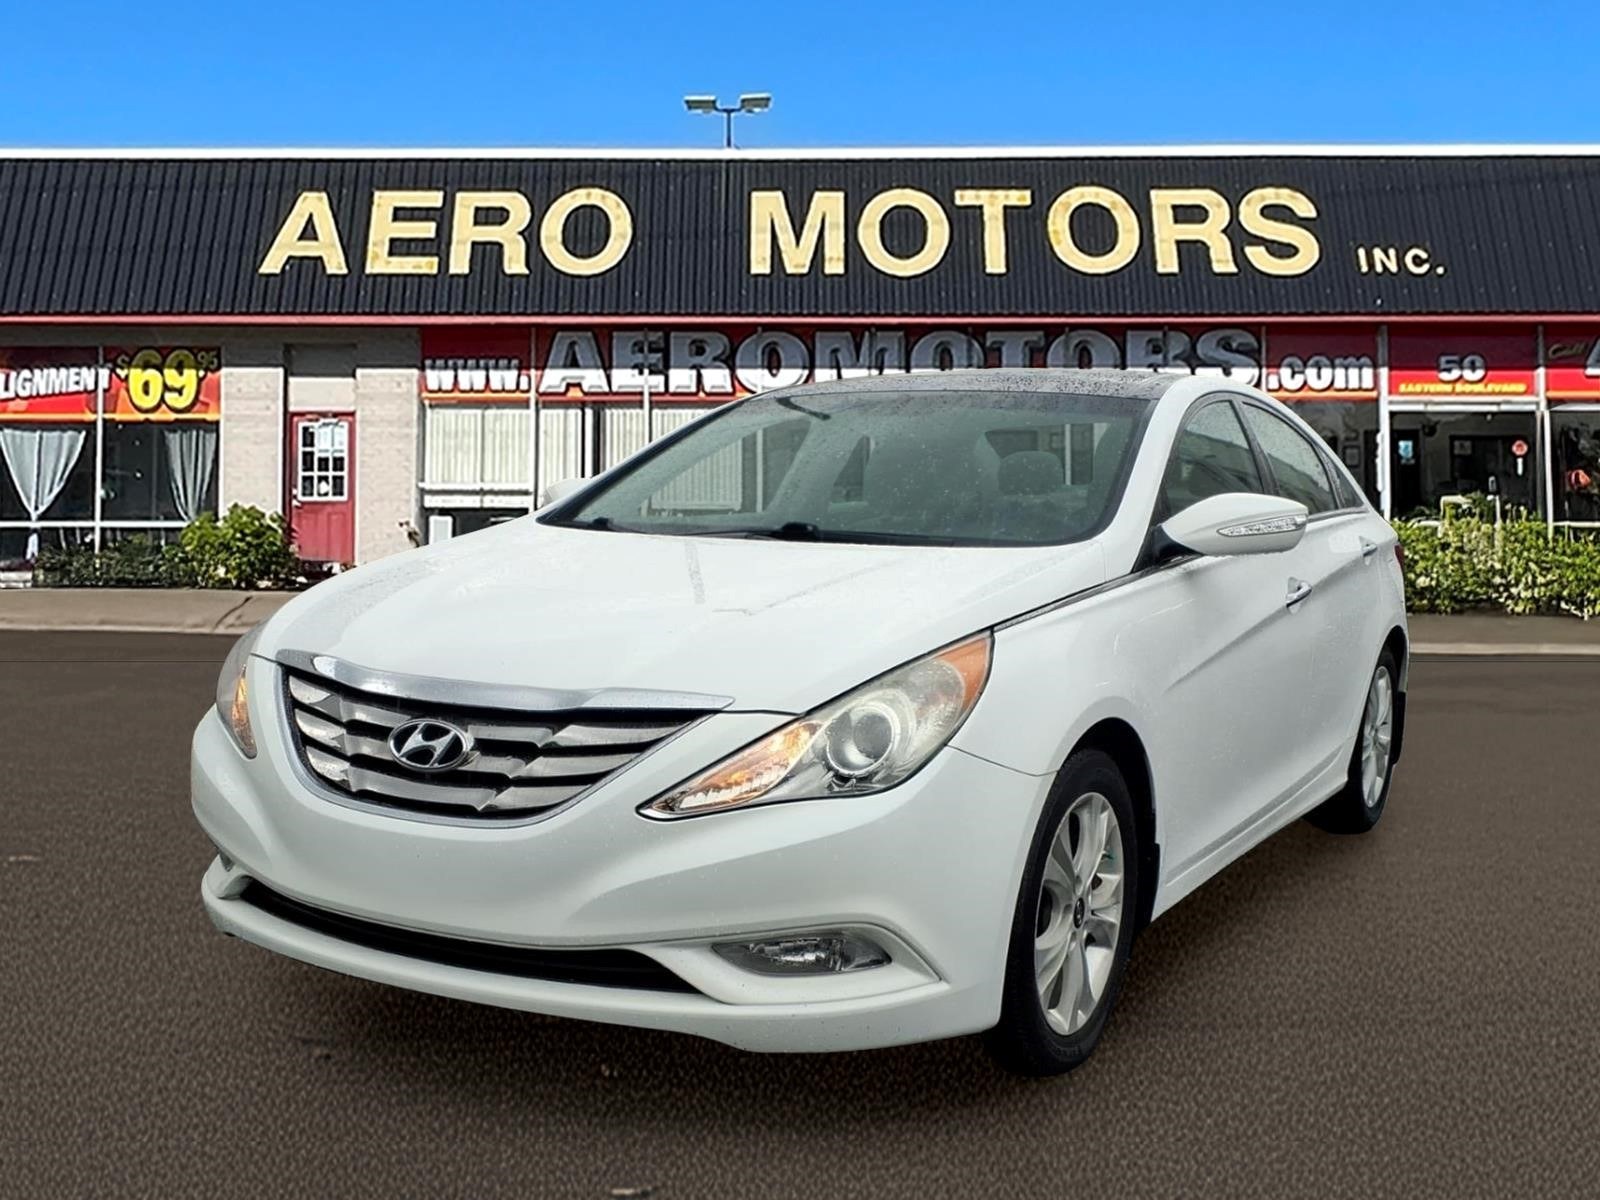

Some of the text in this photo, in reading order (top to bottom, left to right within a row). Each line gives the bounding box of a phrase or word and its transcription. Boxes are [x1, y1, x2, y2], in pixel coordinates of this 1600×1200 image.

[258, 187, 1445, 277] AERO MOTORS INC.
[1438, 355, 1486, 381] 50
